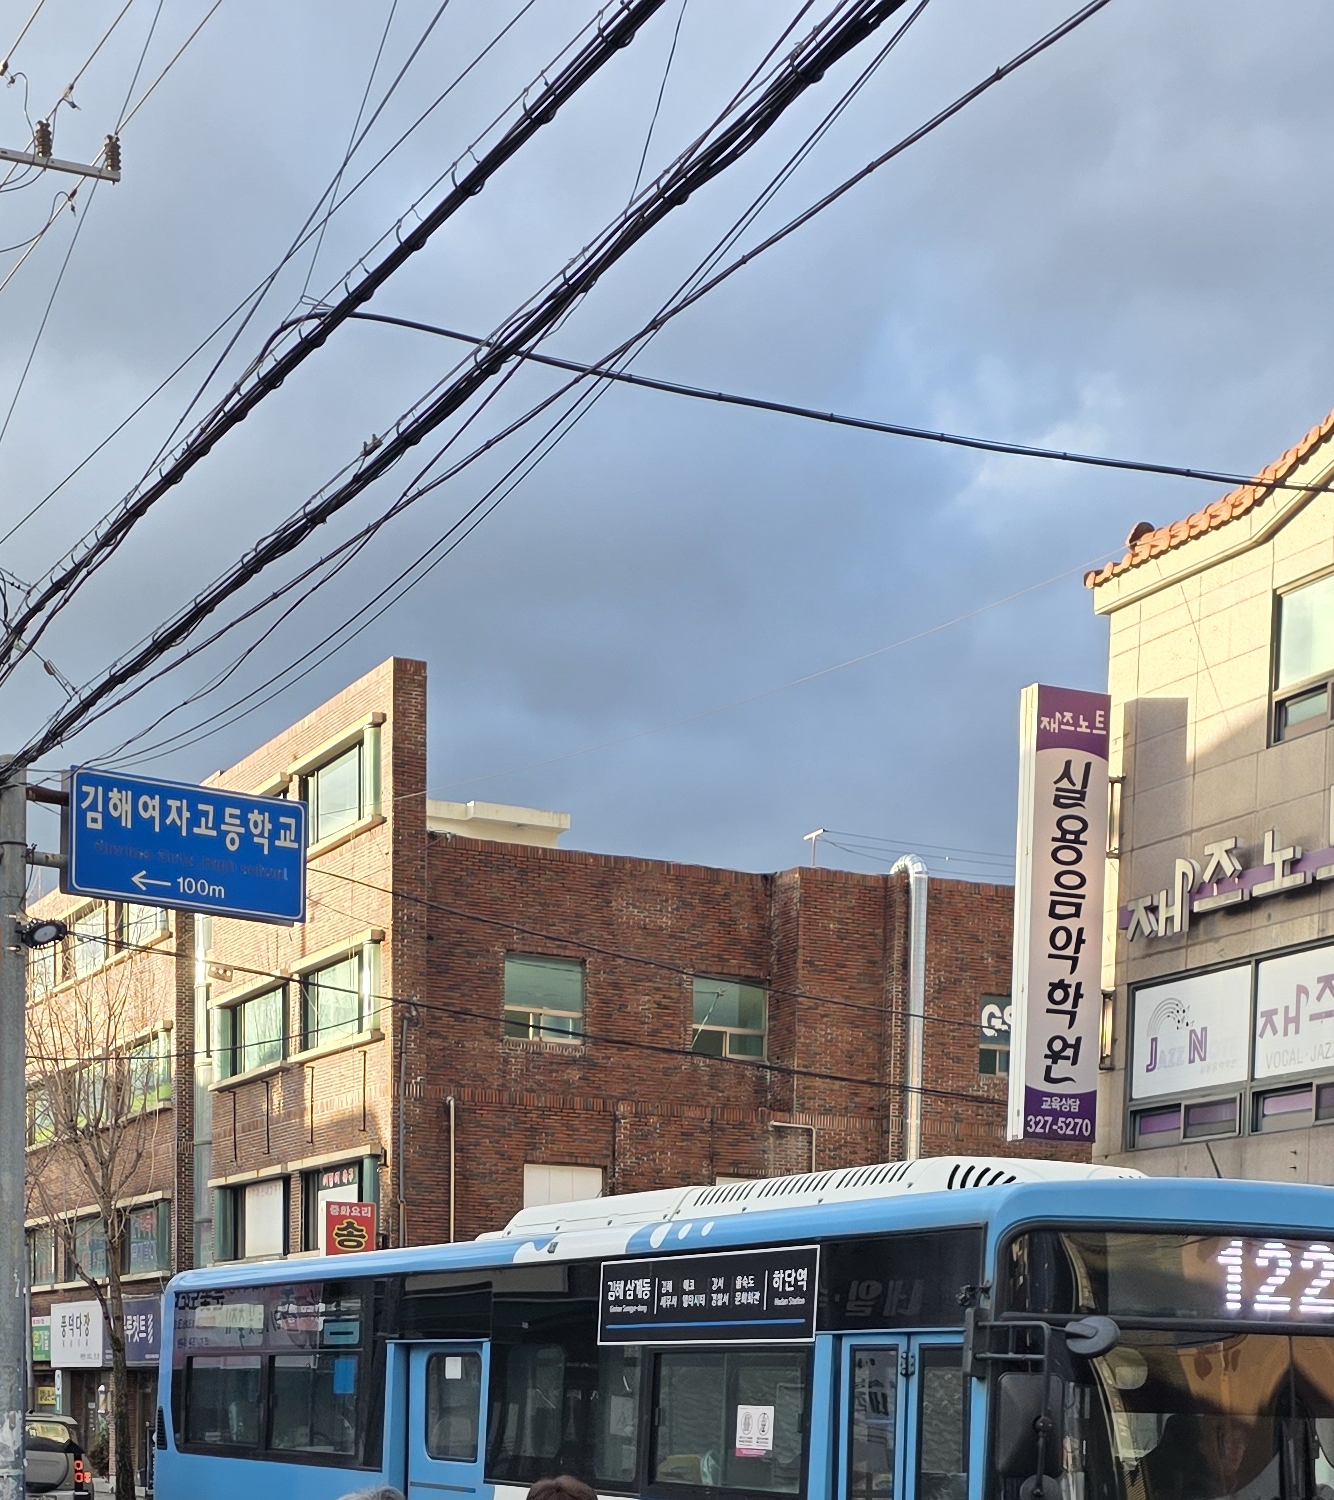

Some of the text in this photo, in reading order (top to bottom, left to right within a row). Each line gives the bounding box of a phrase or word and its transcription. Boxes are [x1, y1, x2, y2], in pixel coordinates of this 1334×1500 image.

[1039, 707, 1108, 734] 재즈노트
[80, 784, 299, 855] 김해여자고등학교
[176, 875, 225, 899] 100m
[1044, 758, 1091, 1084] 실용음악학원
[1040, 1096, 1081, 1113] 교육상담
[1026, 1114, 1092, 1137] 327-5270
[334, 1219, 368, 1250] 송
[607, 1278, 651, 1301] 김해 삼계동
[772, 1267, 808, 1292] 하단역
